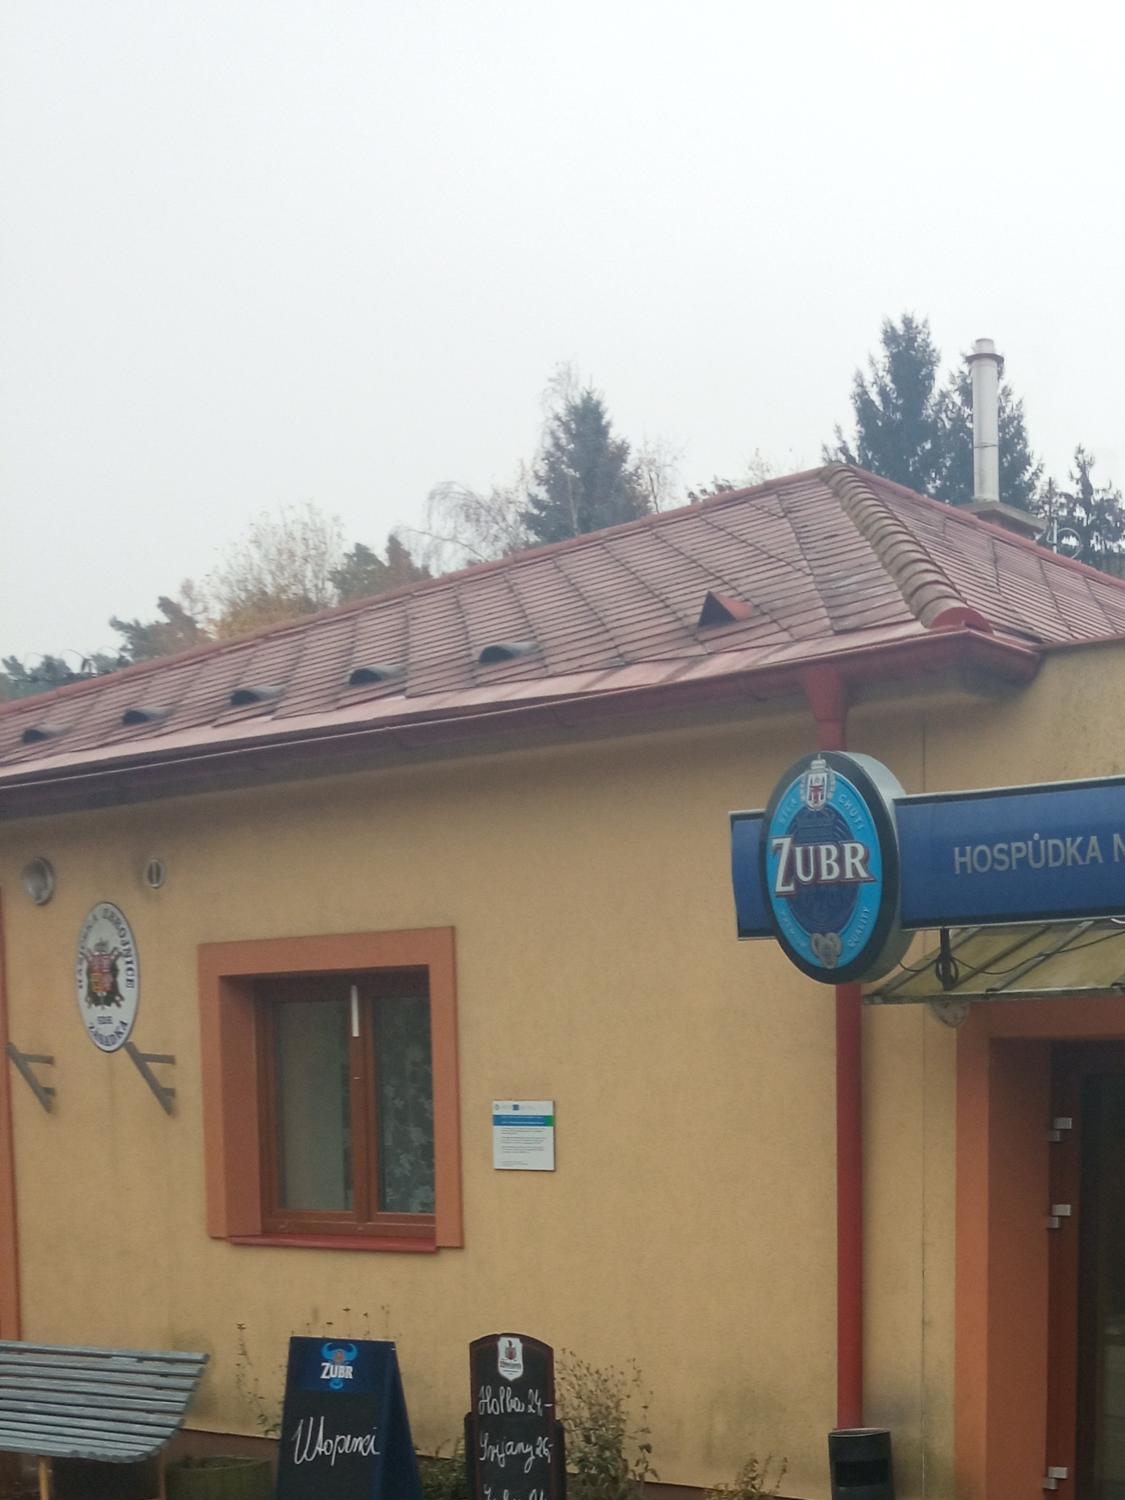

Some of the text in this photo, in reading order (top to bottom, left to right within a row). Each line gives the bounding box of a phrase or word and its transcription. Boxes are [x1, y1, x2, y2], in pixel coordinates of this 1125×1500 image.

[771, 836, 871, 894] ZUBR
[953, 832, 1104, 875] HOSPŮDKA
[320, 1361, 353, 1379] ZUBR
